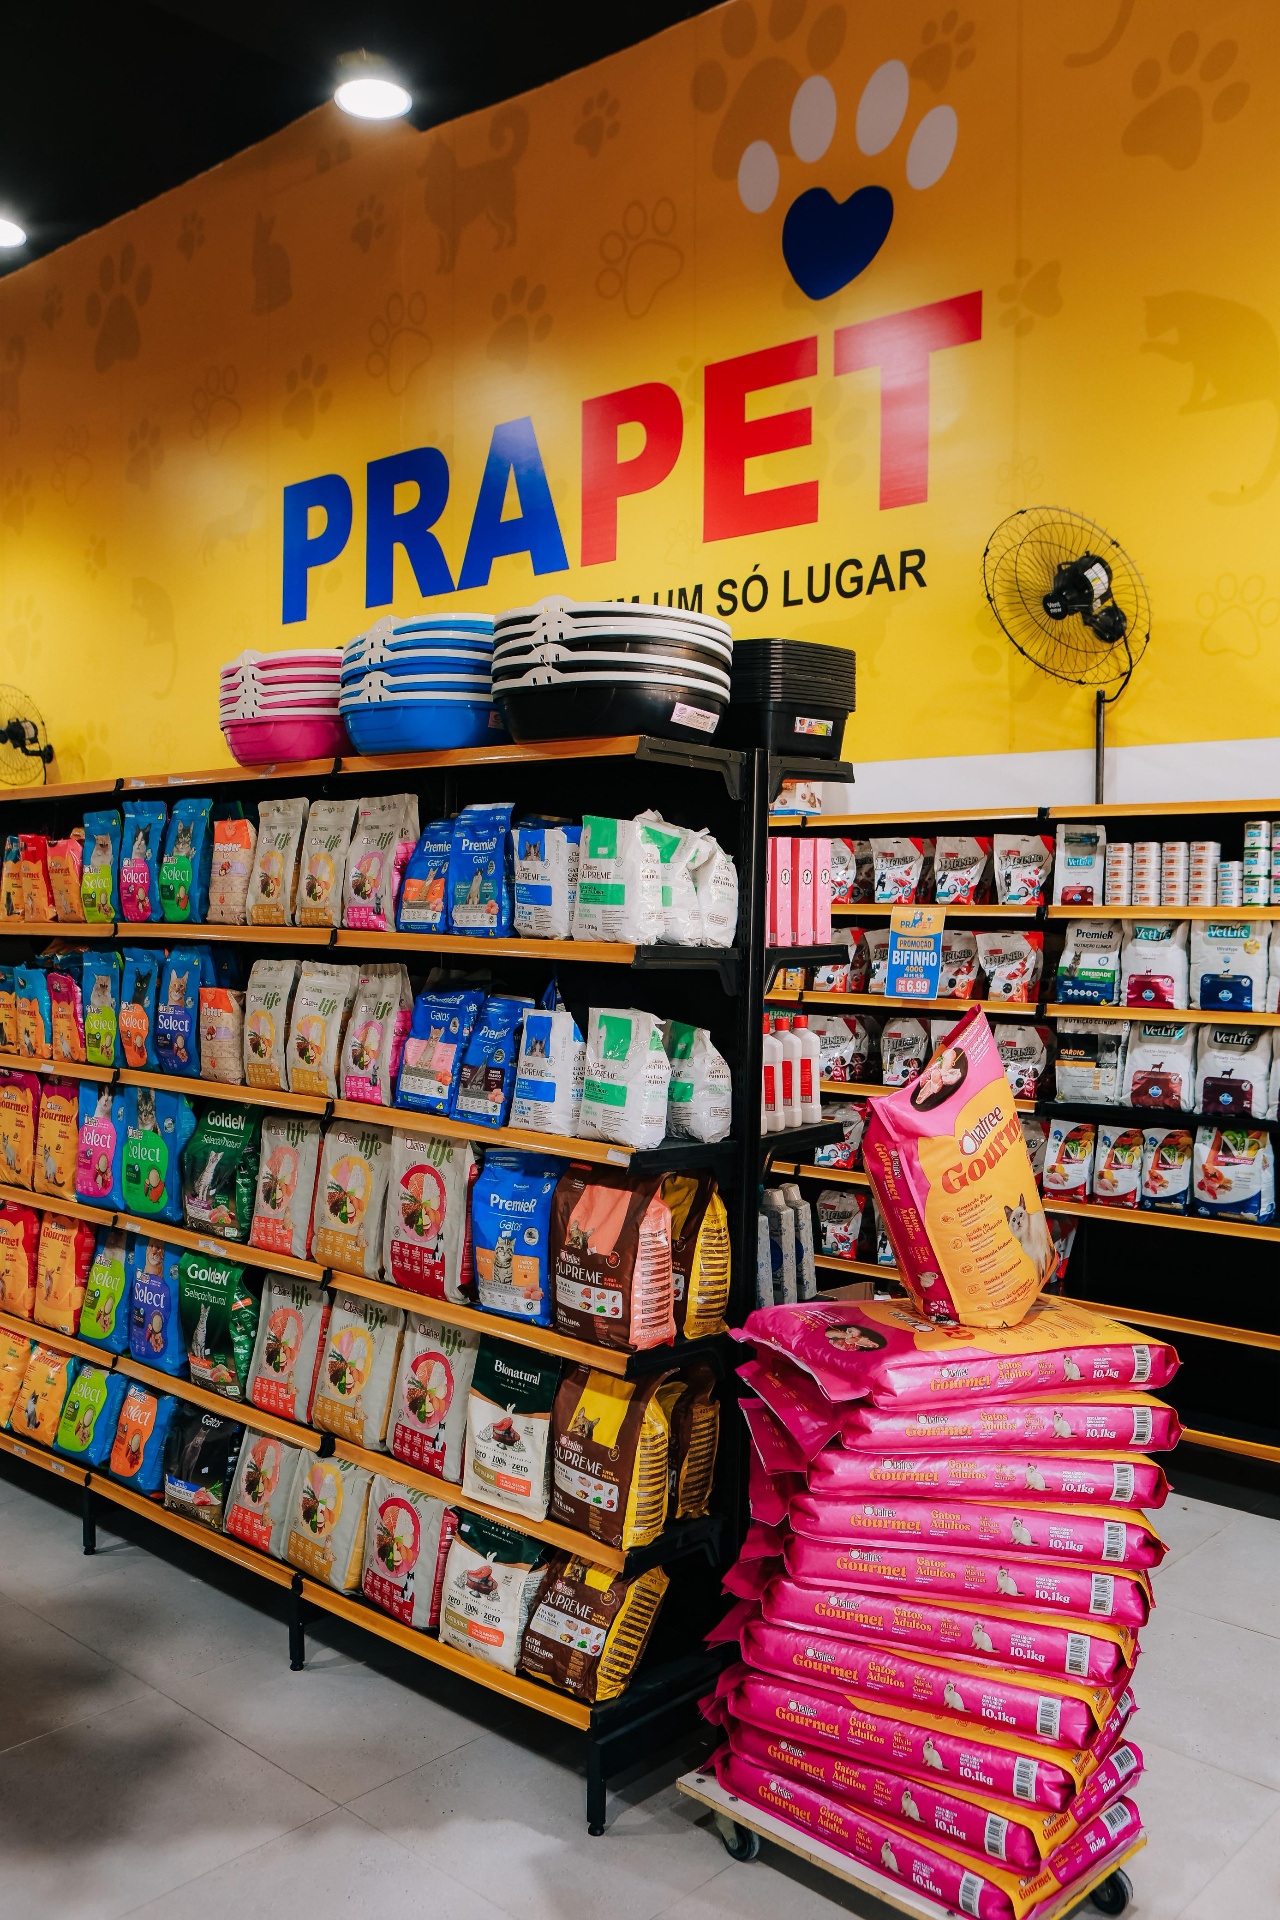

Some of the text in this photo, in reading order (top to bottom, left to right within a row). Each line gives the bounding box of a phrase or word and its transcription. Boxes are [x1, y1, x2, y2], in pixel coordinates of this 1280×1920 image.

[282, 290, 983, 625] PRAPET
[716, 563, 769, 617] SÓ
[782, 548, 928, 608] LUGAR
[423, 840, 451, 853] Premie
[1068, 857, 1092, 866] VetLife
[83, 875, 111, 889] Select
[122, 869, 148, 884] Select
[162, 867, 190, 882] Select
[900, 920, 933, 929] PRAPET
[1210, 925, 1249, 938] VetLife
[1076, 928, 1113, 940] PremieR
[892, 950, 938, 966] BIFINHO
[905, 965, 923, 973] 400G
[1081, 970, 1112, 978] OBESIDADE
[906, 980, 928, 993] 6,99
[87, 1015, 117, 1031] Select
[120, 1011, 147, 1030] Select
[157, 1014, 190, 1032] Select
[1144, 1024, 1180, 1038] VetLife
[1214, 1031, 1254, 1044] VetLife
[1060, 1048, 1085, 1056] CARDIO
[0, 1099, 30, 1114] ourmet
[40, 1107, 74, 1124] Gourmet
[207, 1110, 246, 1131] GoldeN
[81, 1126, 112, 1149] Select
[286, 1121, 308, 1148] life
[958, 1106, 1003, 1157] Quatree
[128, 1140, 160, 1163] Select
[359, 1131, 383, 1160] life
[426, 1136, 454, 1168] life
[489, 1193, 538, 1213] PremieR
[499, 1219, 522, 1231] Gatos
[900, 1207, 916, 1240] Adultos
[42, 1226, 73, 1245] Gourmet
[91, 1267, 121, 1291] Select
[187, 1263, 230, 1286] GoldeN
[555, 1256, 604, 1286] SUPREME
[134, 1282, 166, 1309] Select
[291, 1283, 312, 1309] life
[364, 1303, 388, 1331] life
[440, 1325, 467, 1356] life
[494, 1359, 541, 1386] Bionatural
[997, 1360, 1022, 1370] Gatos
[1092, 1368, 1119, 1379] 10,1kg
[930, 1374, 992, 1392] Gourmet
[998, 1369, 1032, 1380] Adultos
[73, 1379, 101, 1403] Select
[123, 1398, 152, 1427] Select
[201, 1413, 223, 1429] Gatos
[980, 1411, 1008, 1421] Gatos
[905, 1425, 973, 1437] Gourmet
[981, 1420, 1018, 1431] Adultos
[1086, 1428, 1116, 1438] 10,1kg
[554, 1440, 603, 1477] SUPREME
[948, 1459, 977, 1469] Gatos
[511, 1462, 529, 1473] zero
[869, 1469, 939, 1482] Gourmet
[948, 1469, 987, 1480] Adultos
[1061, 1483, 1094, 1494] 10,1kg
[850, 1514, 922, 1531] Gourmet
[930, 1510, 960, 1521] Gatos
[930, 1519, 971, 1531] Adultos
[1048, 1538, 1084, 1552] 10,1kg
[850, 1548, 883, 1562] Quatree
[916, 1556, 947, 1568] Gatos
[836, 1556, 907, 1578] Gourmet
[915, 1565, 957, 1580] Adultos
[541, 1586, 594, 1620] SUPREME
[1035, 1589, 1071, 1604] 10,1kg
[447, 1594, 461, 1606] zero
[483, 1611, 501, 1624] zero
[814, 1602, 884, 1627] Gourmet
[893, 1606, 923, 1620] Gatos
[892, 1617, 933, 1632] Adultos
[1010, 1646, 1045, 1663] 10,1kg
[792, 1653, 859, 1681] Gourmet
[868, 1661, 897, 1676] Gatos
[565, 1677, 577, 1687] 3kg
[866, 1672, 905, 1689] Adultos
[775, 1706, 840, 1736] Gourmet
[849, 1716, 877, 1732] Gatos
[981, 1707, 1017, 1725] 10,1kg
[847, 1726, 885, 1745] Adultos
[767, 1744, 825, 1779] Gourmet
[834, 1760, 860, 1779] Gatos
[832, 1771, 867, 1791] Adultos
[959, 1766, 994, 1786] 10,1kg
[758, 1785, 812, 1823] Gourmet
[820, 1805, 844, 1825] Gatos
[818, 1816, 849, 1839] Adultos
[934, 1818, 967, 1840] 10,1kg
[1042, 1811, 1071, 1841] Gourmet
[912, 1873, 942, 1897] 10,1kg
[1018, 1871, 1052, 1901] Gourmet
